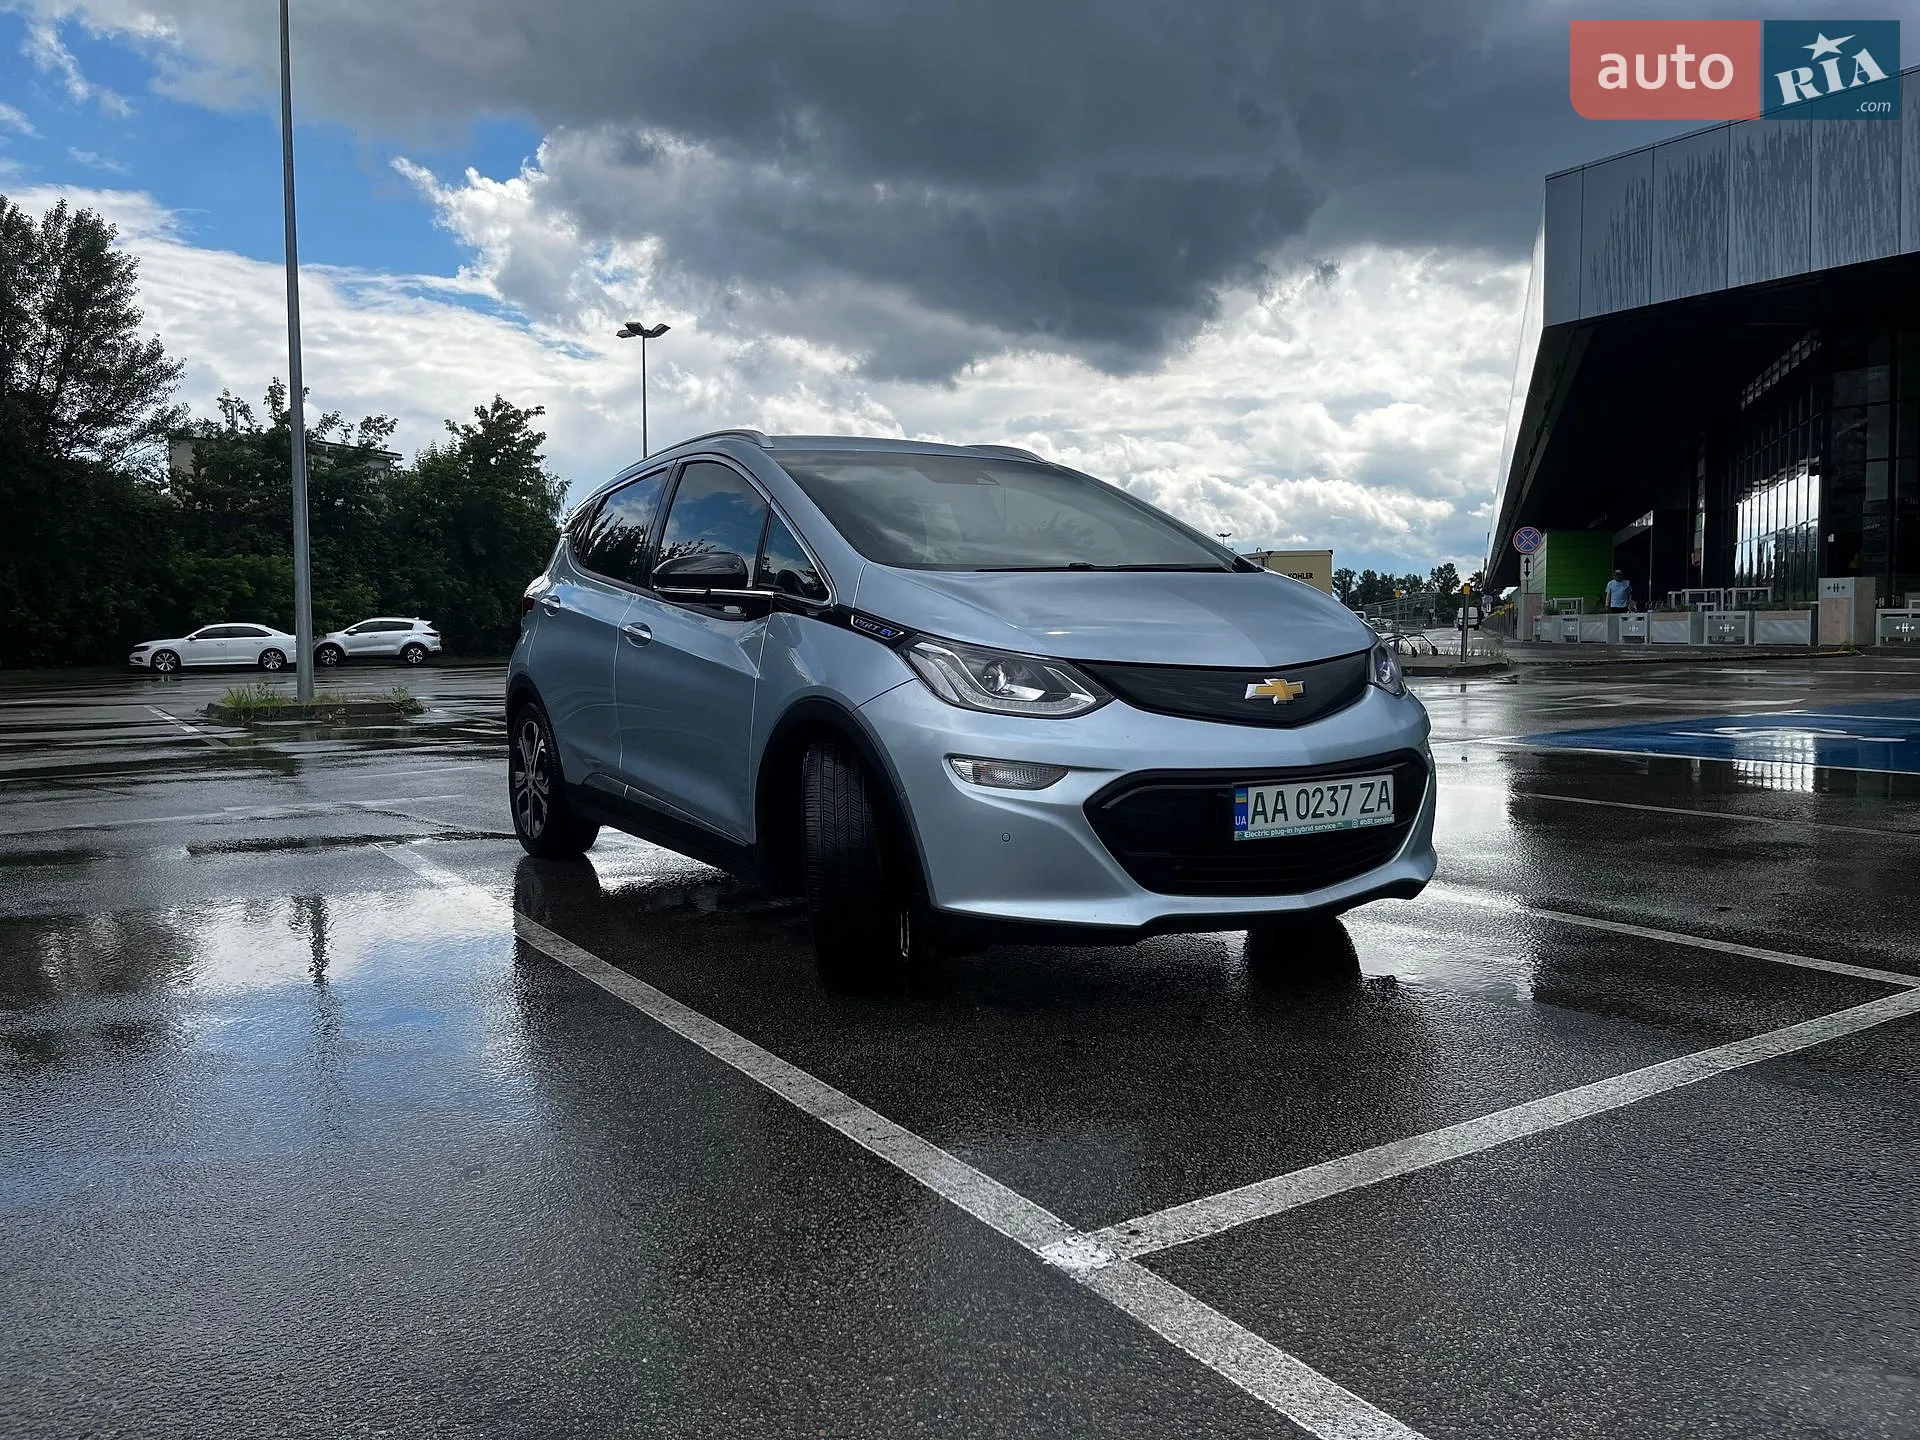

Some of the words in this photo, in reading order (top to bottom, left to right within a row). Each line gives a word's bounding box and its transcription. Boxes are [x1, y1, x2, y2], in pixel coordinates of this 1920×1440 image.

[1288, 572, 1314, 580] KOHLER
[1250, 790, 1289, 825] AA
[1295, 783, 1353, 820] 0237
[1359, 780, 1392, 814] ZA
[1235, 815, 1247, 826] UA
[1244, 829, 1270, 838] Electric
[1270, 827, 1293, 838] plug-in
[1294, 825, 1314, 835] hybrid
[1314, 822, 1336, 832] service
